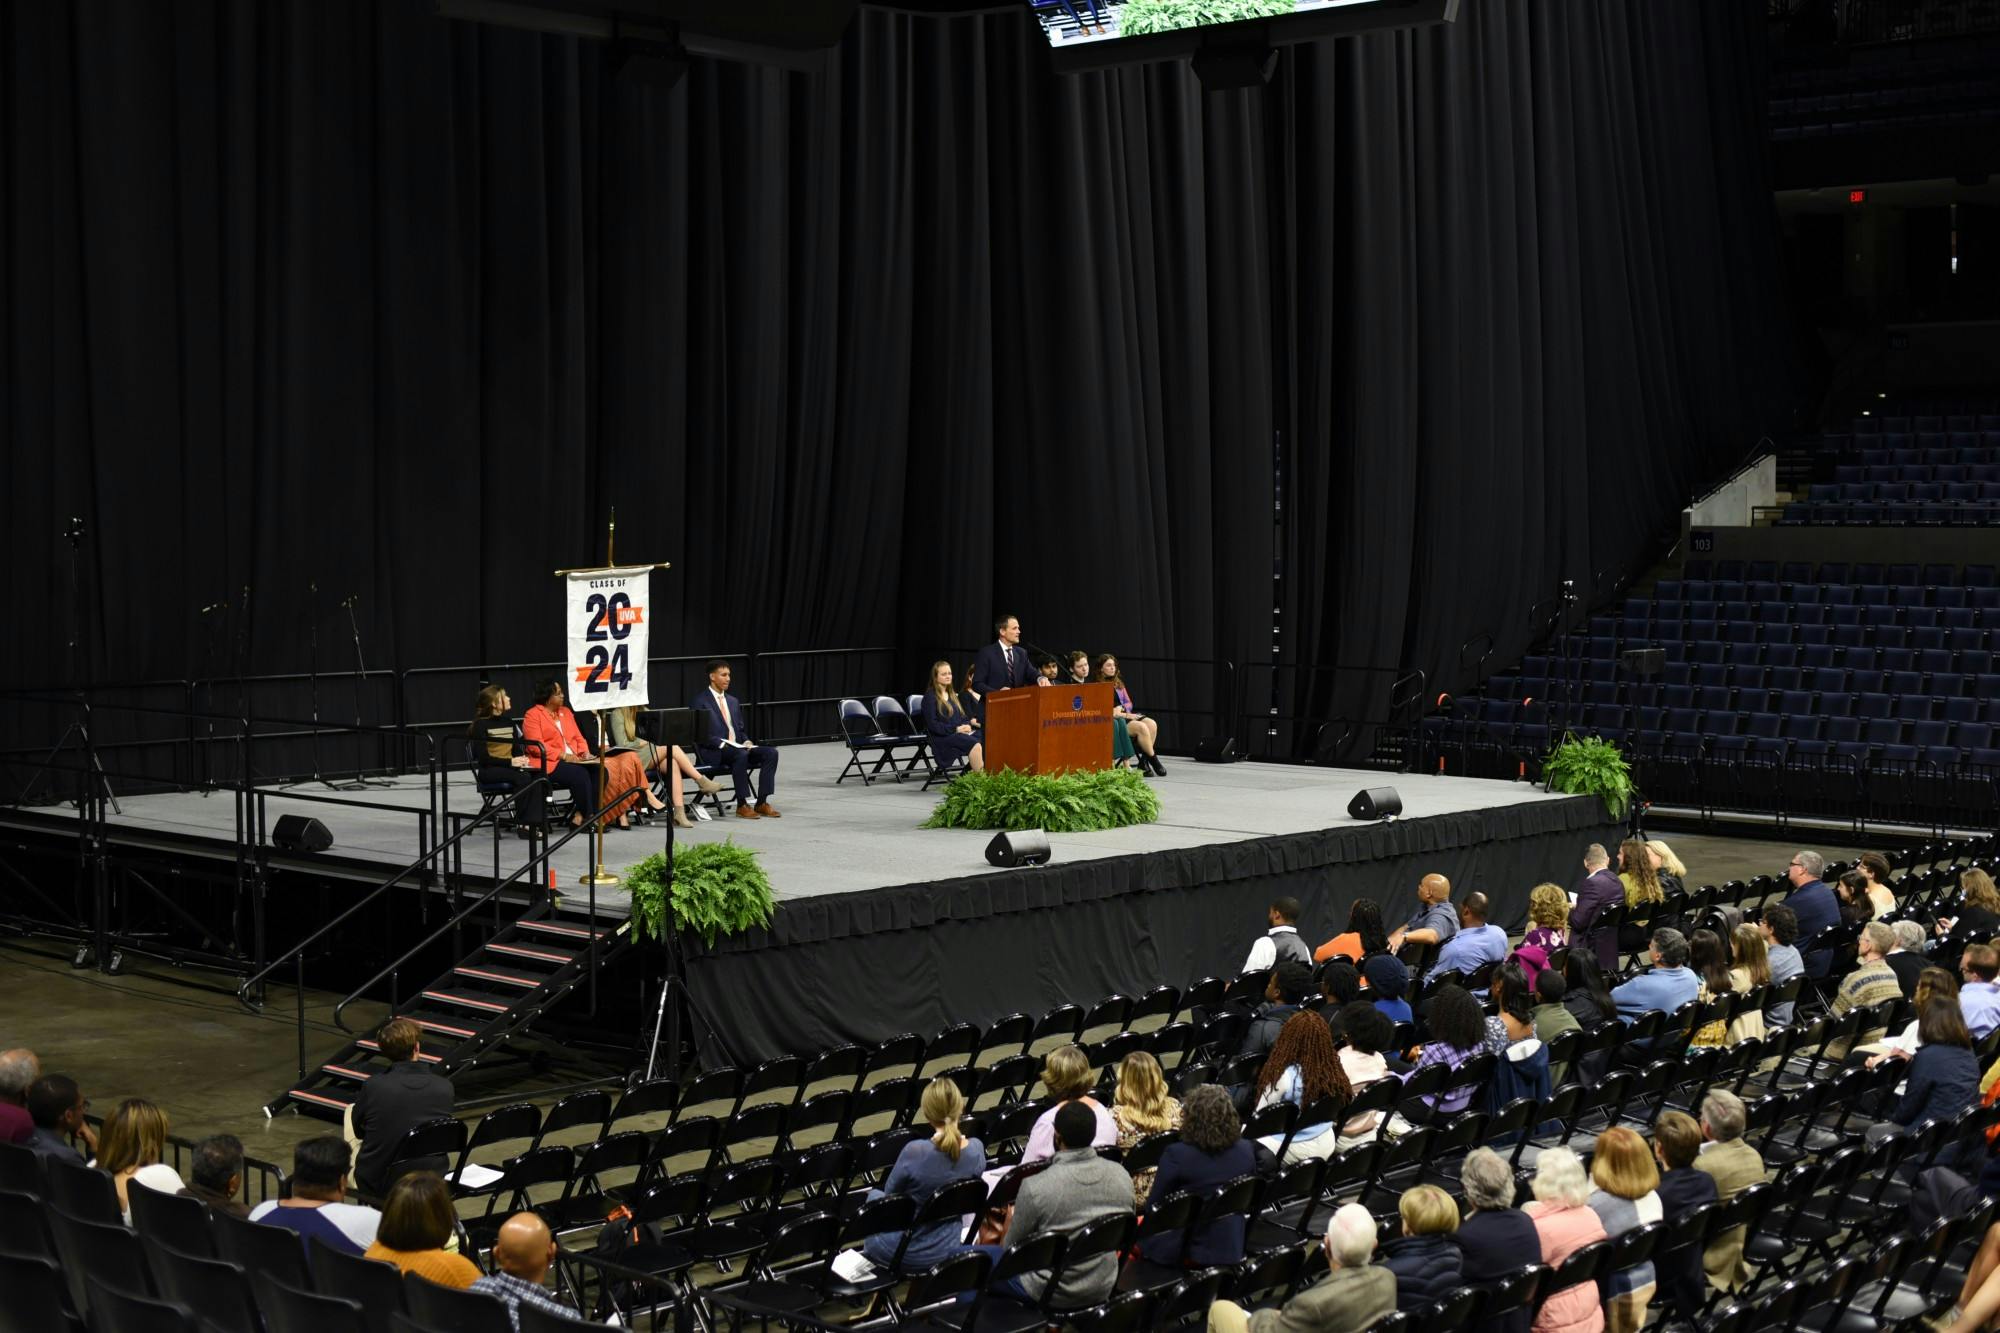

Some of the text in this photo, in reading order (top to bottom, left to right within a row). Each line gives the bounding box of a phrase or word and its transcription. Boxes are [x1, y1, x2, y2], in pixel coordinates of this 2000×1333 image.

[1695, 539, 1711, 550] 103
[590, 578, 627, 589] CLASS OF
[586, 592, 632, 642] 20
[619, 609, 637, 622] UVA
[584, 644, 633, 694] 24
